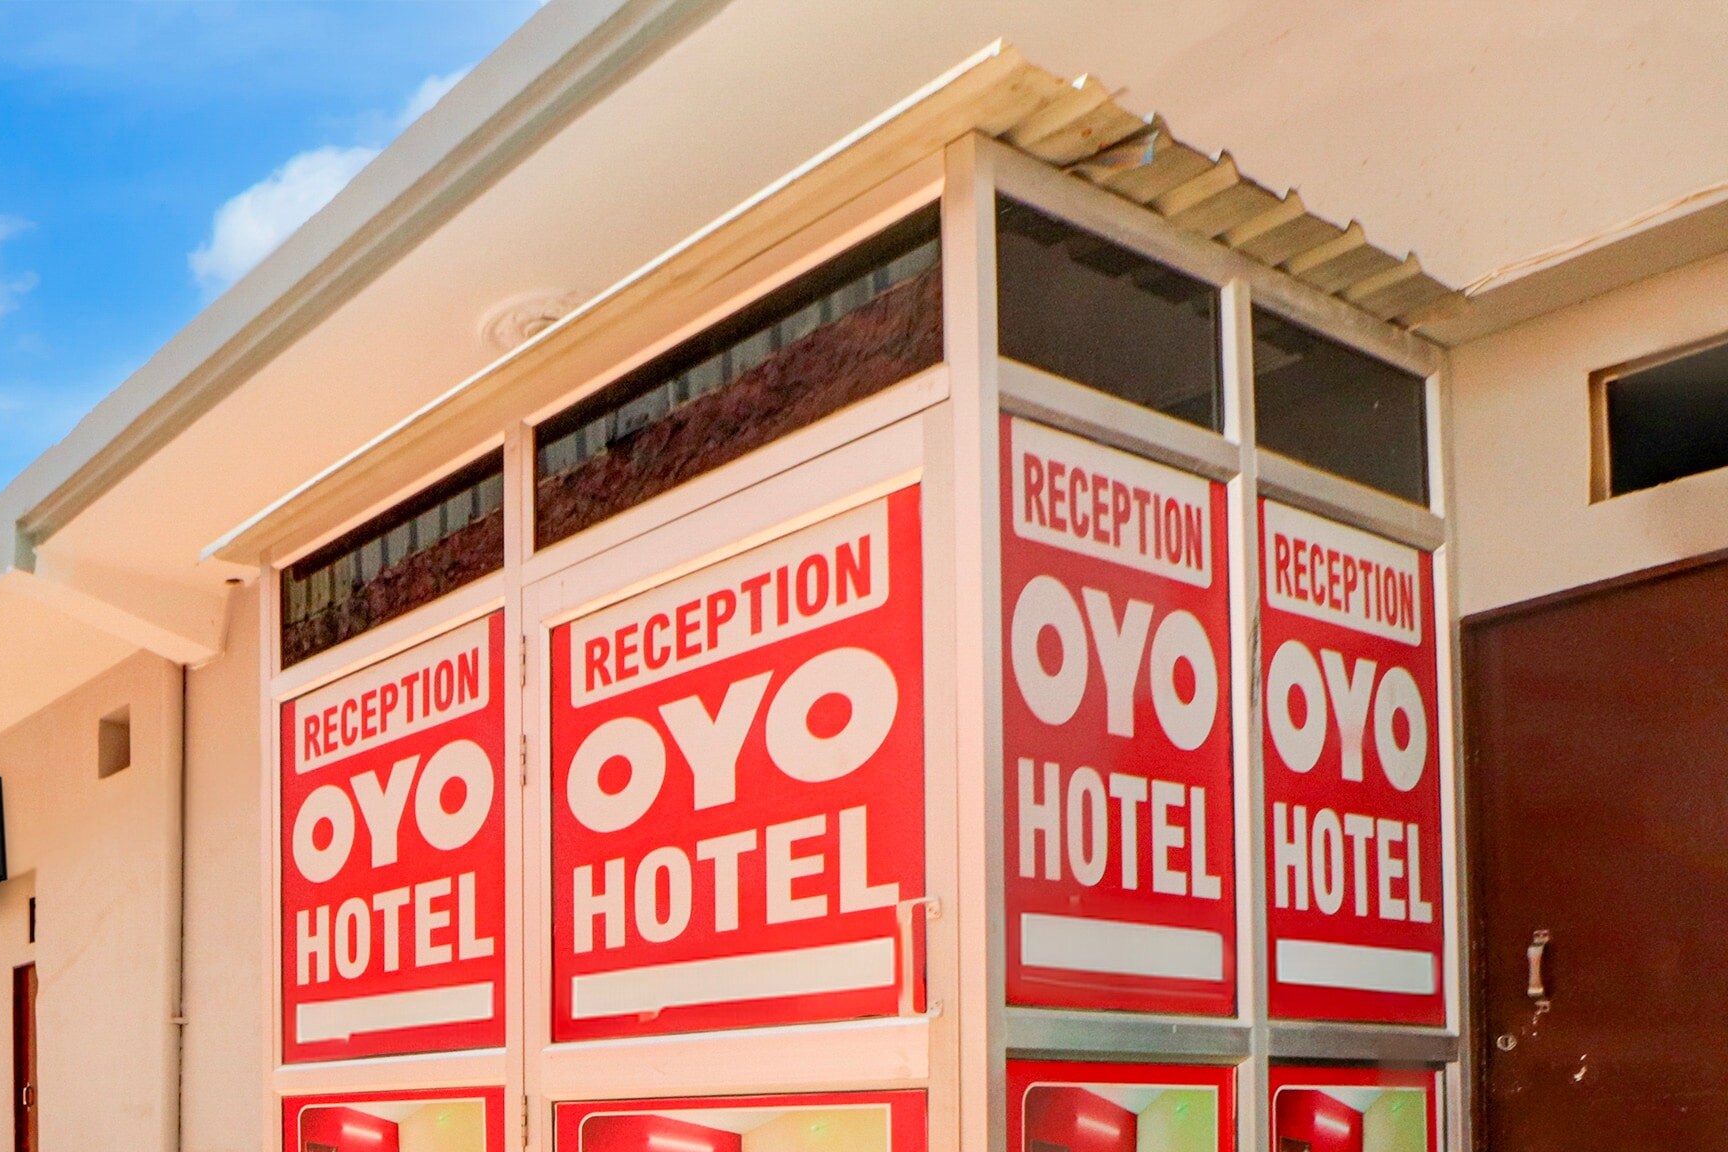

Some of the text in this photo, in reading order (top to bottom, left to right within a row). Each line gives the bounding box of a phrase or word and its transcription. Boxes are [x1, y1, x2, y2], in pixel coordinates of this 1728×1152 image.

[1024, 453, 1203, 572] RECEPTION
[1275, 533, 1415, 631] RECEPTION
[584, 534, 872, 692] RECEPTION
[1011, 574, 1218, 751] OYO
[304, 646, 480, 762] RECEPTION
[566, 646, 899, 832] OYO
[1267, 640, 1427, 792] OYO
[293, 738, 494, 883] OYO
[573, 804, 899, 954] HOTEL
[1017, 758, 1222, 900] HOTEL
[1273, 801, 1433, 924] HOTEL
[297, 872, 495, 986] HOTEL
